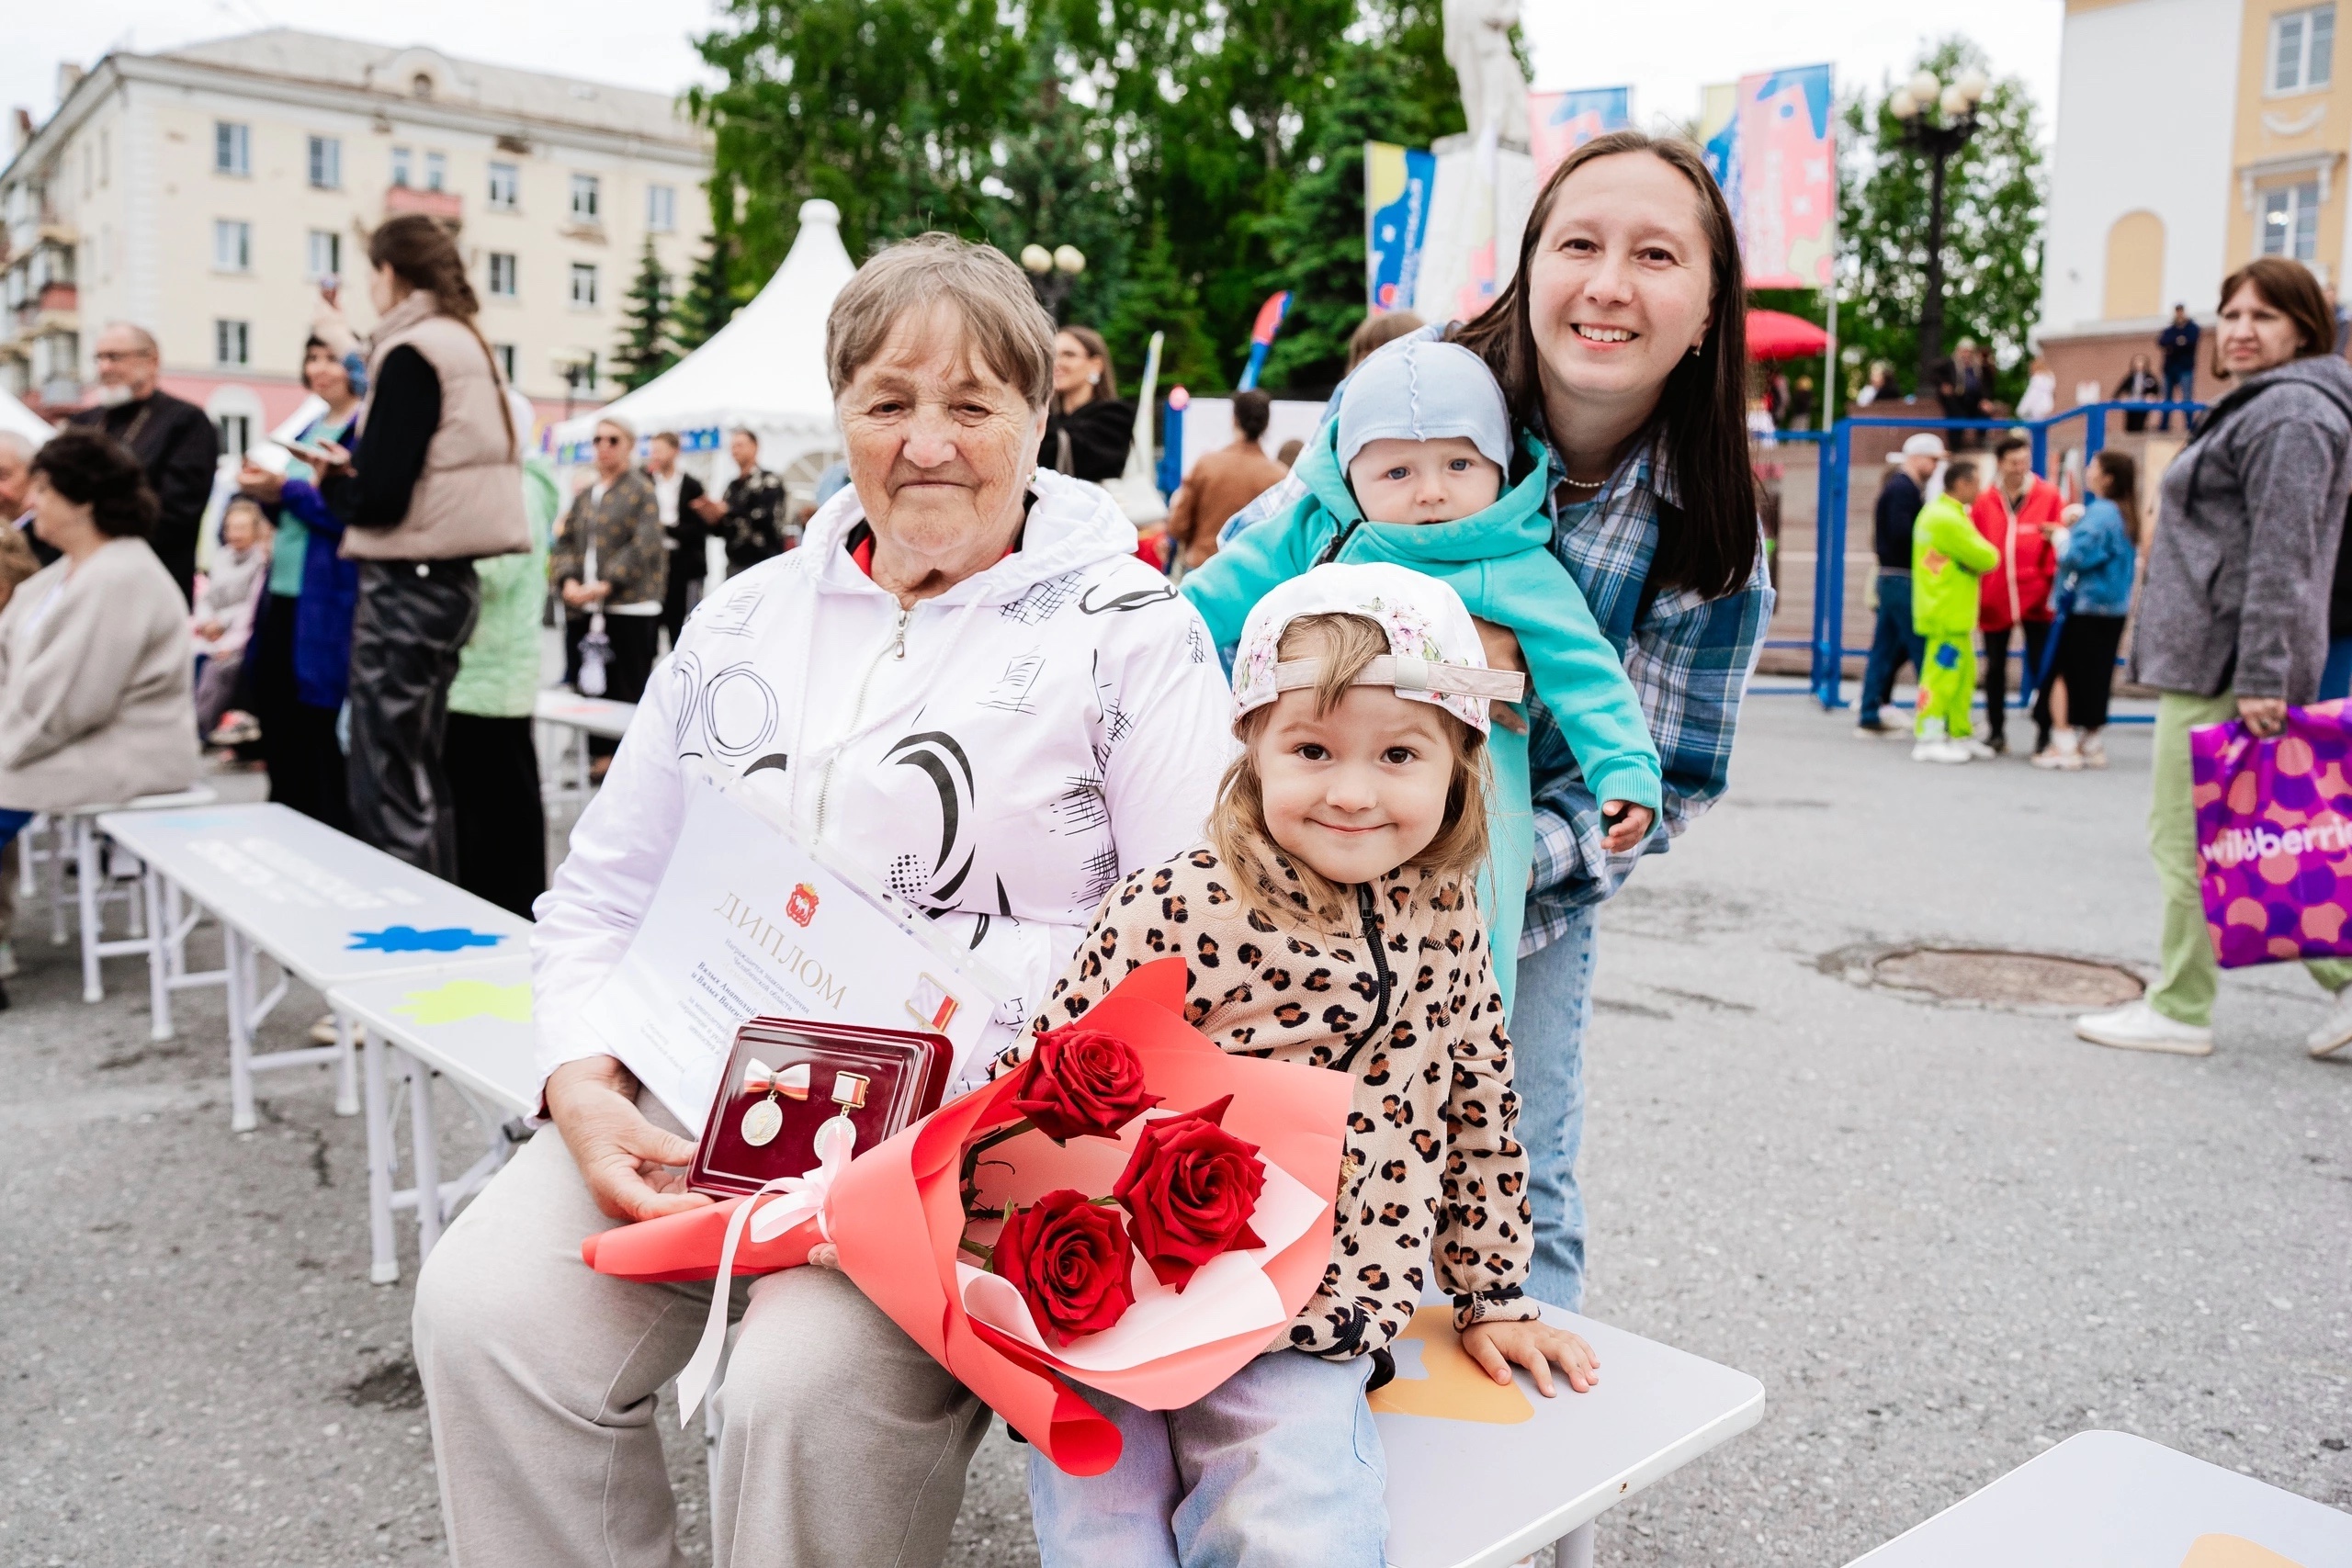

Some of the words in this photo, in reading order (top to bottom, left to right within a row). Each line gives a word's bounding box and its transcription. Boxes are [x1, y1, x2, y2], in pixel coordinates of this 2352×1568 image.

[714, 891, 848, 1010] ДИПЛОМ
[723, 937, 765, 976] Награждается
[763, 971, 786, 993] знаком
[783, 989, 810, 1016] отличия
[695, 974, 720, 999] Вялых
[695, 960, 721, 986] Вялых
[718, 980, 758, 1017] Анатолий
[731, 955, 770, 992] Челябинской
[768, 987, 794, 1012] области
